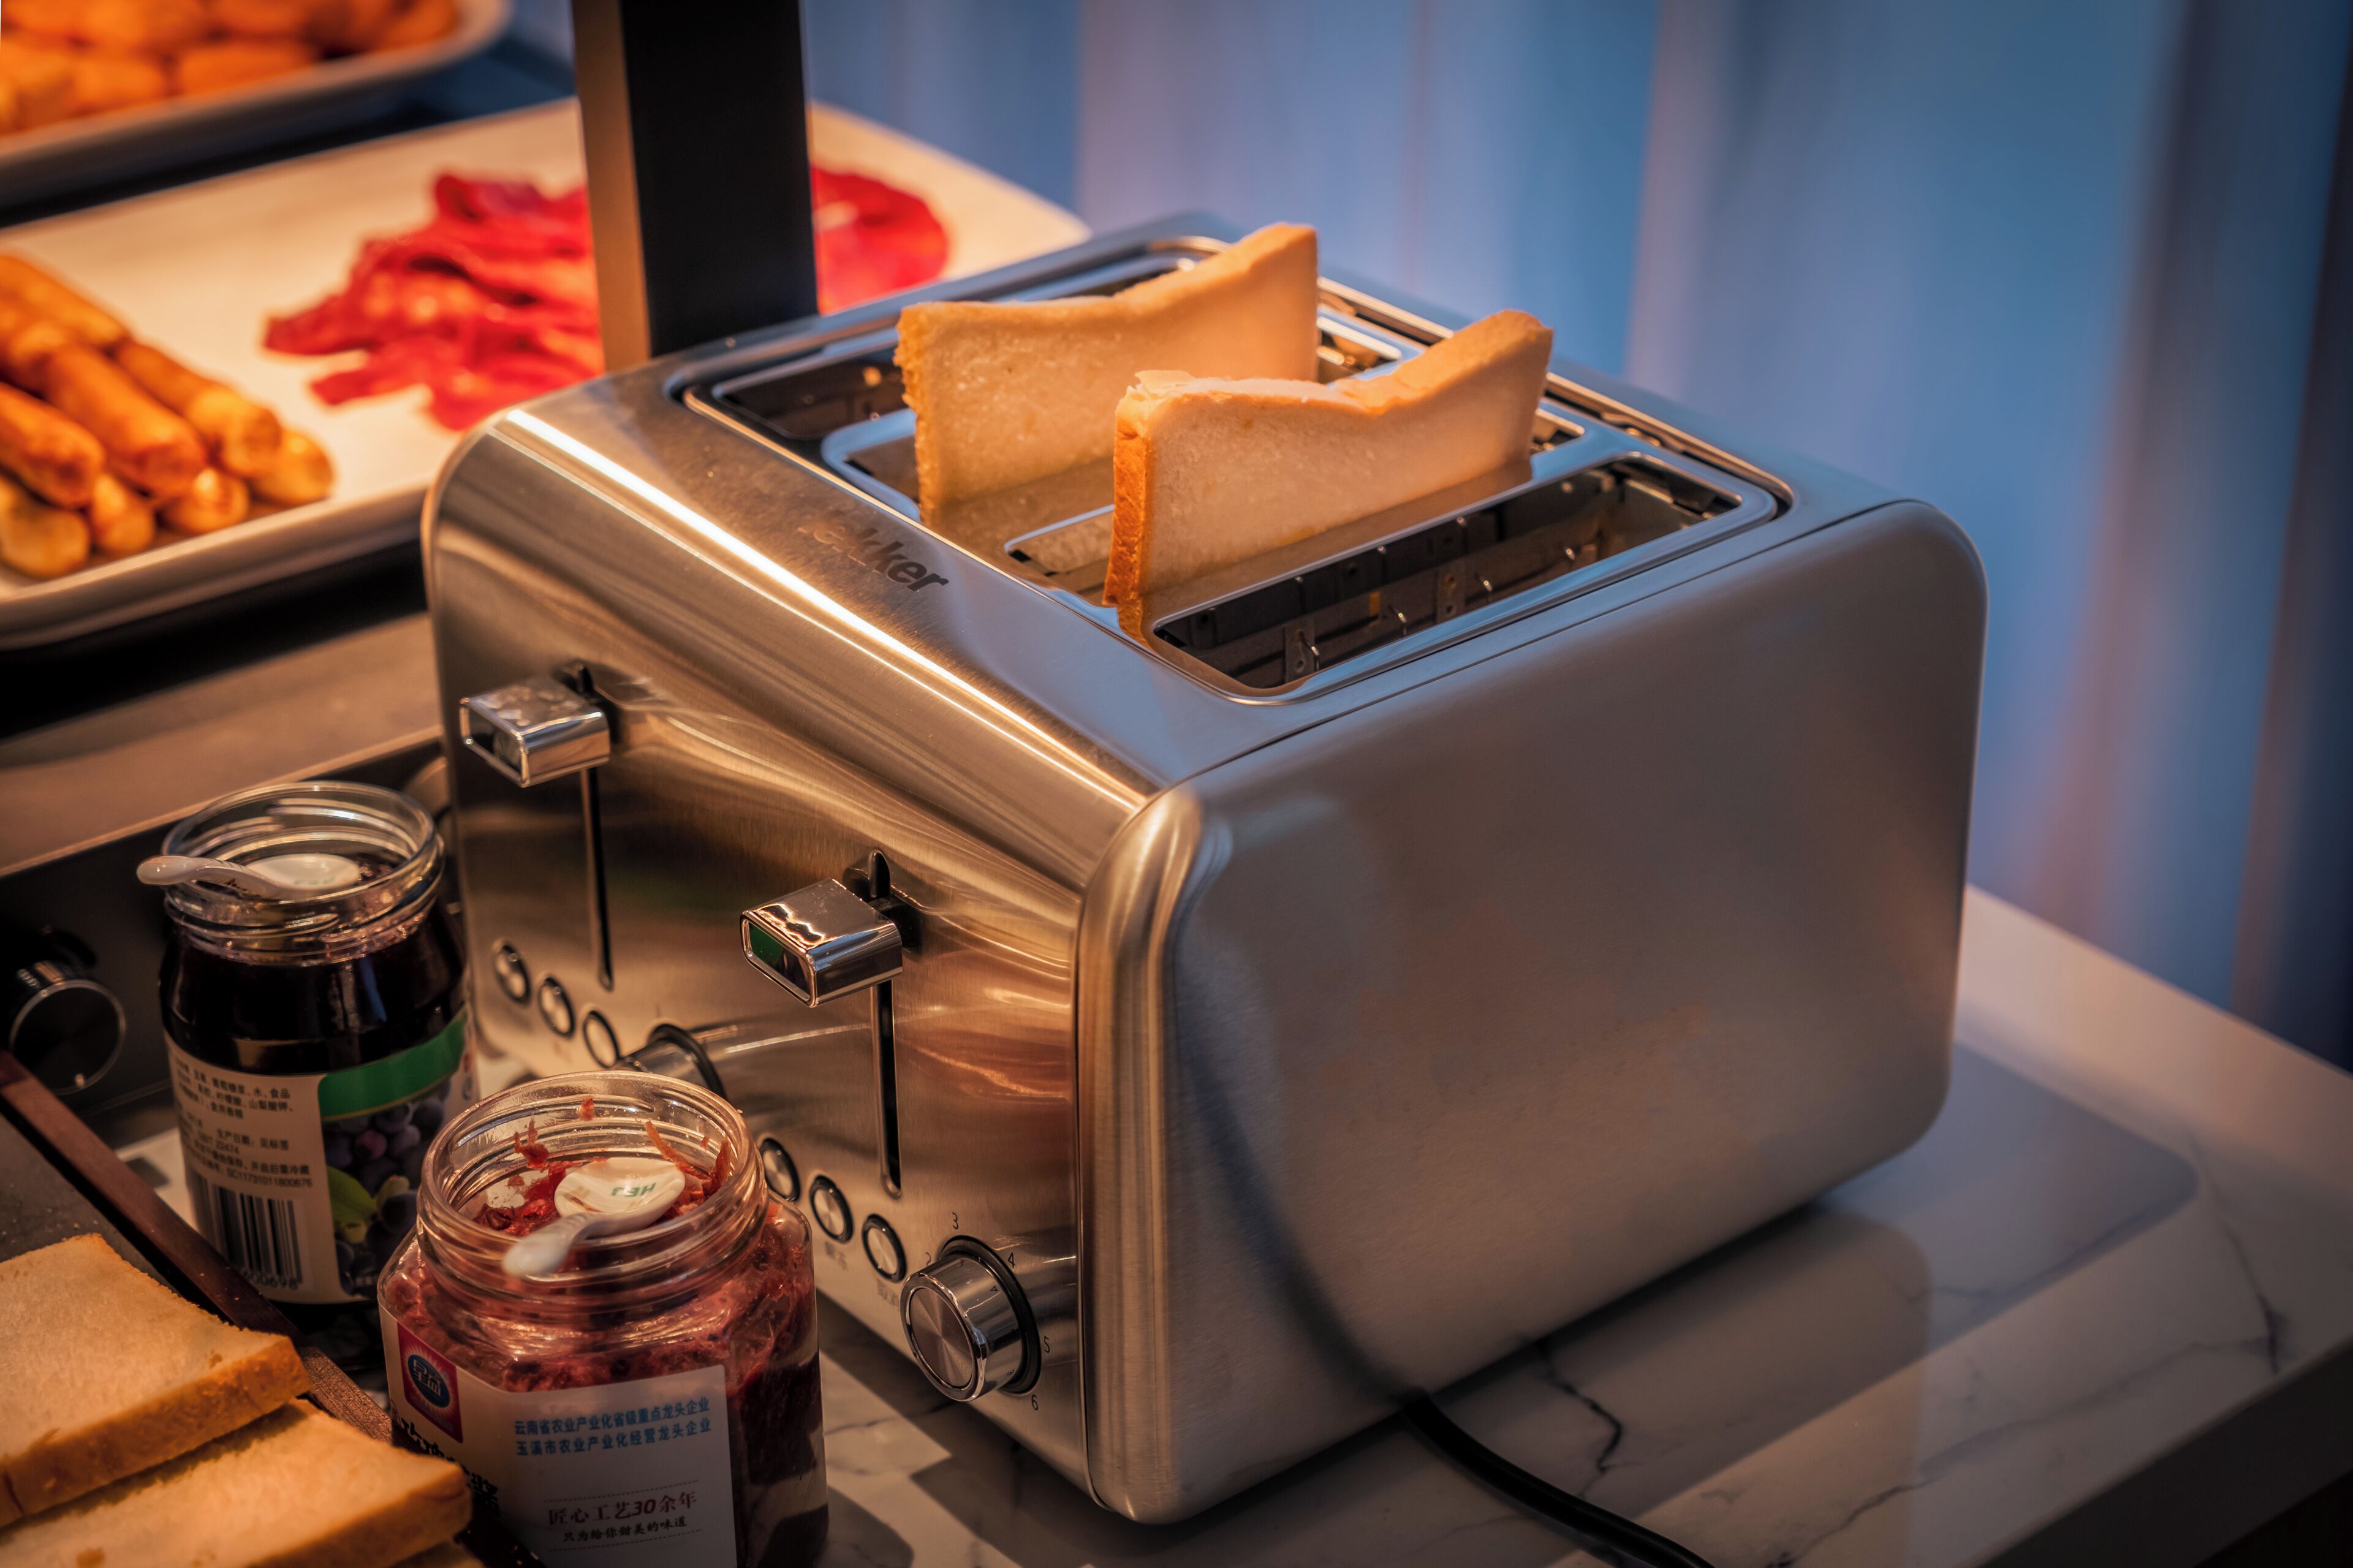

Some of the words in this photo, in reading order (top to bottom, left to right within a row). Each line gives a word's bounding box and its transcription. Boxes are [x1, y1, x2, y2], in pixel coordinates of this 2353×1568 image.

[952, 1212, 959, 1230] 3
[1007, 1252, 1015, 1268] 4
[1044, 1336, 1050, 1353] 5
[1031, 1394, 1039, 1411] 6
[514, 1396, 710, 1435] 云南省农业产业化省级重点龙头企业
[516, 1417, 711, 1456] 玉溪市农业产业化经营龙头企业
[549, 1491, 697, 1526] 匠心工艺30余年
